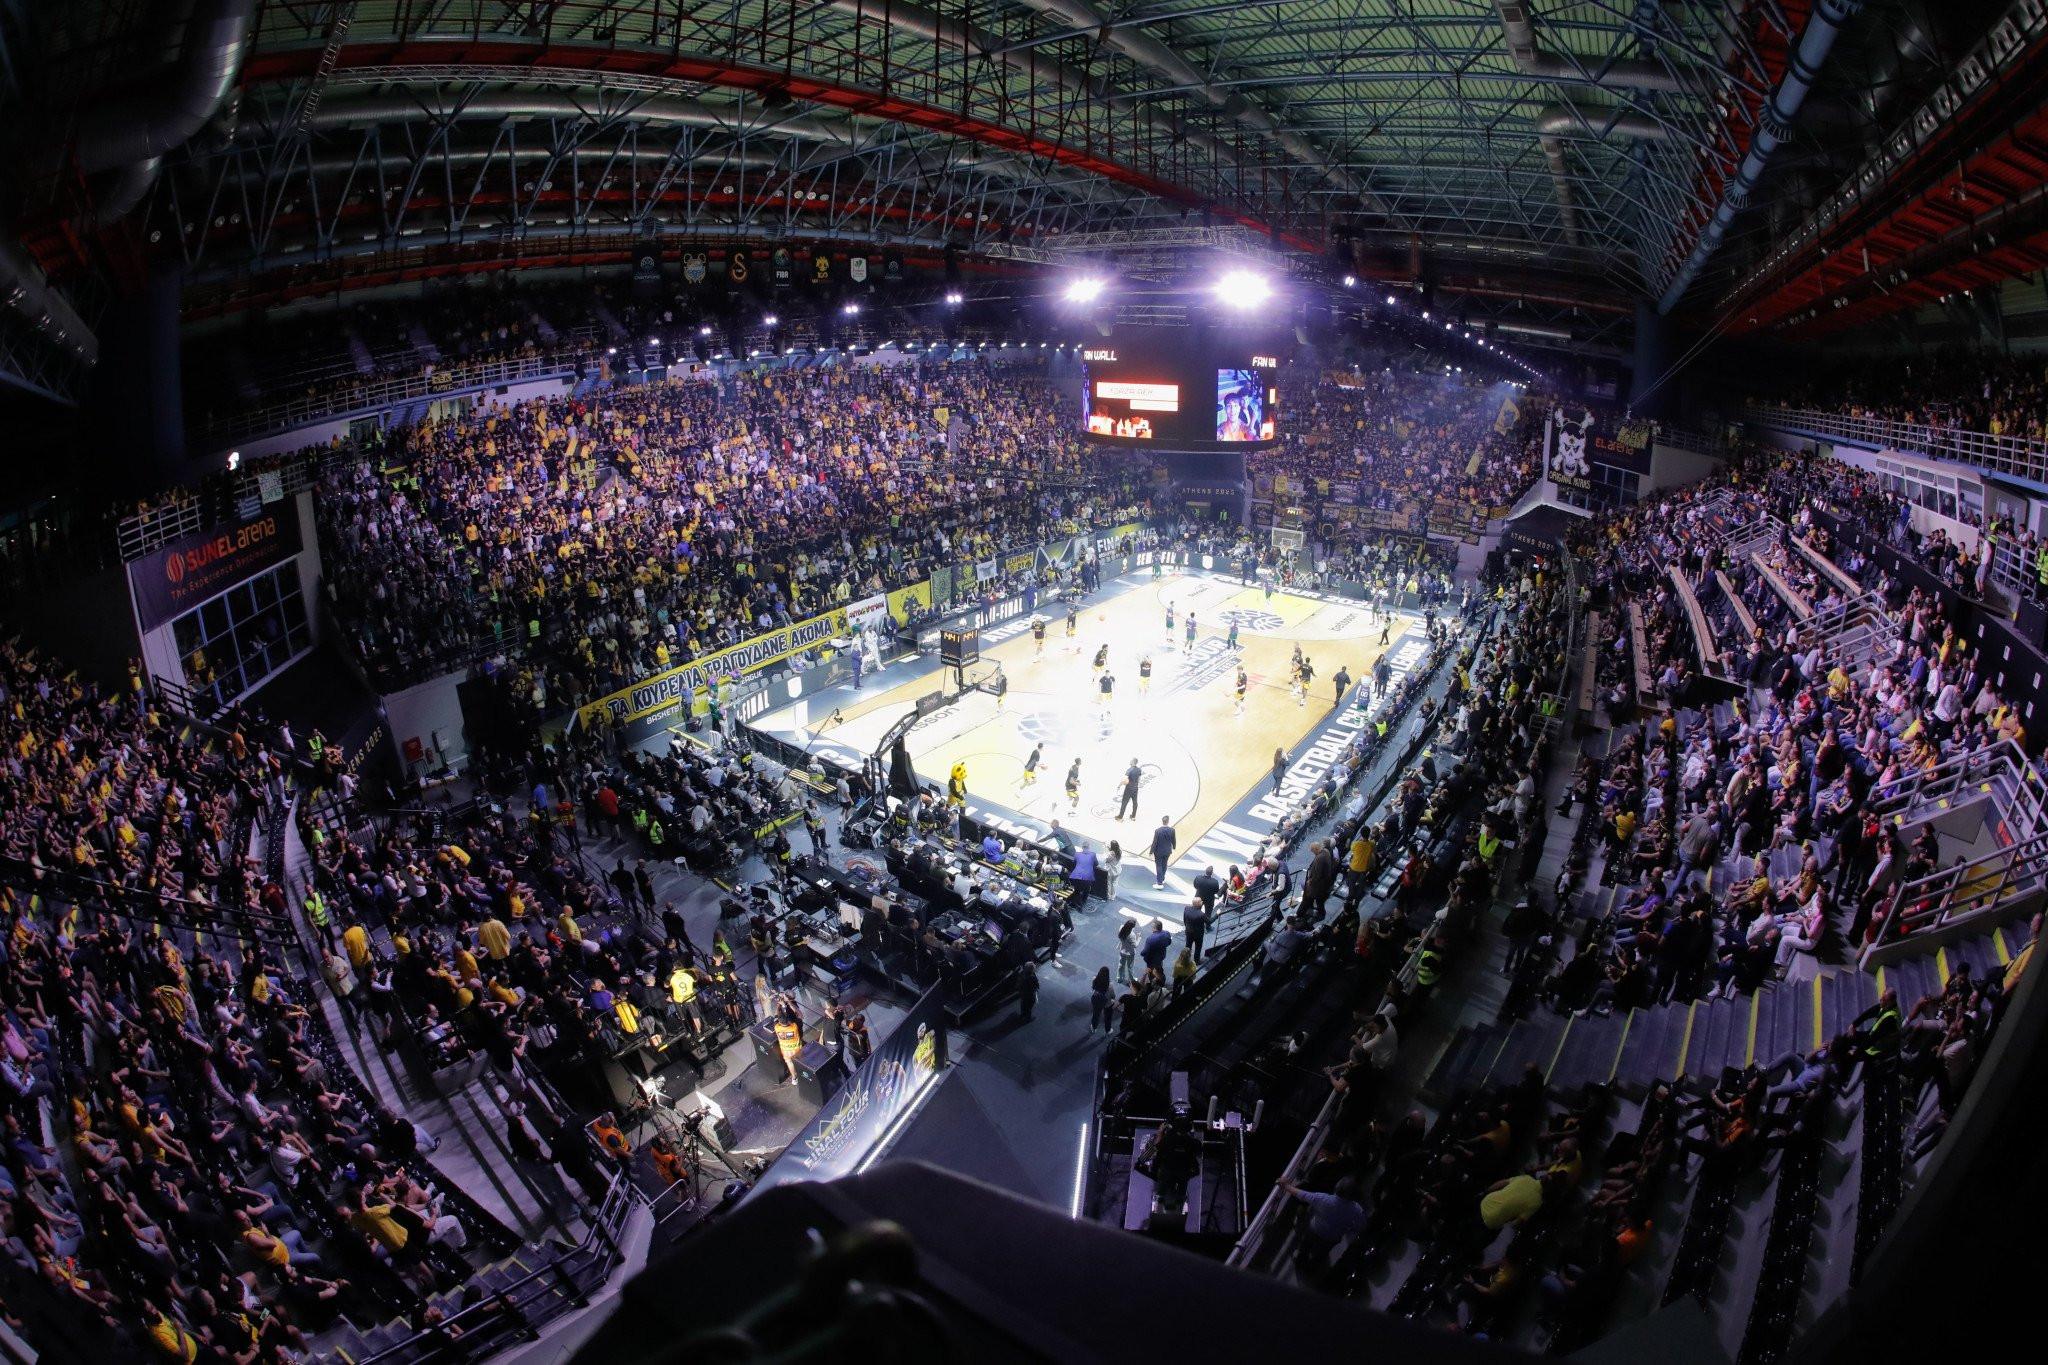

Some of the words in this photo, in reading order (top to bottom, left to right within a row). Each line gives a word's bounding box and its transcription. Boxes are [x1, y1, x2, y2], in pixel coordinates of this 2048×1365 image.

[776, 270, 789, 279] FIBA
[1094, 350, 1118, 361] WALL
[1252, 356, 1268, 367] FAN
[186, 534, 237, 572] SUNEL
[236, 517, 276, 549] arena
[1096, 533, 1125, 553] FINA
[1511, 531, 1535, 546] ATHENS
[1007, 553, 1033, 565] ZURICH
[170, 588, 187, 601] The
[607, 697, 630, 719] ΤΑ
[789, 618, 834, 649] ΑΚΟΜΑ
[646, 704, 683, 725] BASKETB
[905, 707, 960, 732] sson
[365, 726, 383, 753] 2025
[1247, 728, 1358, 824] BASKETBALL
[678, 981, 688, 993] 9
[803, 1128, 840, 1169] FINAL
[840, 1089, 869, 1130] FOUR
